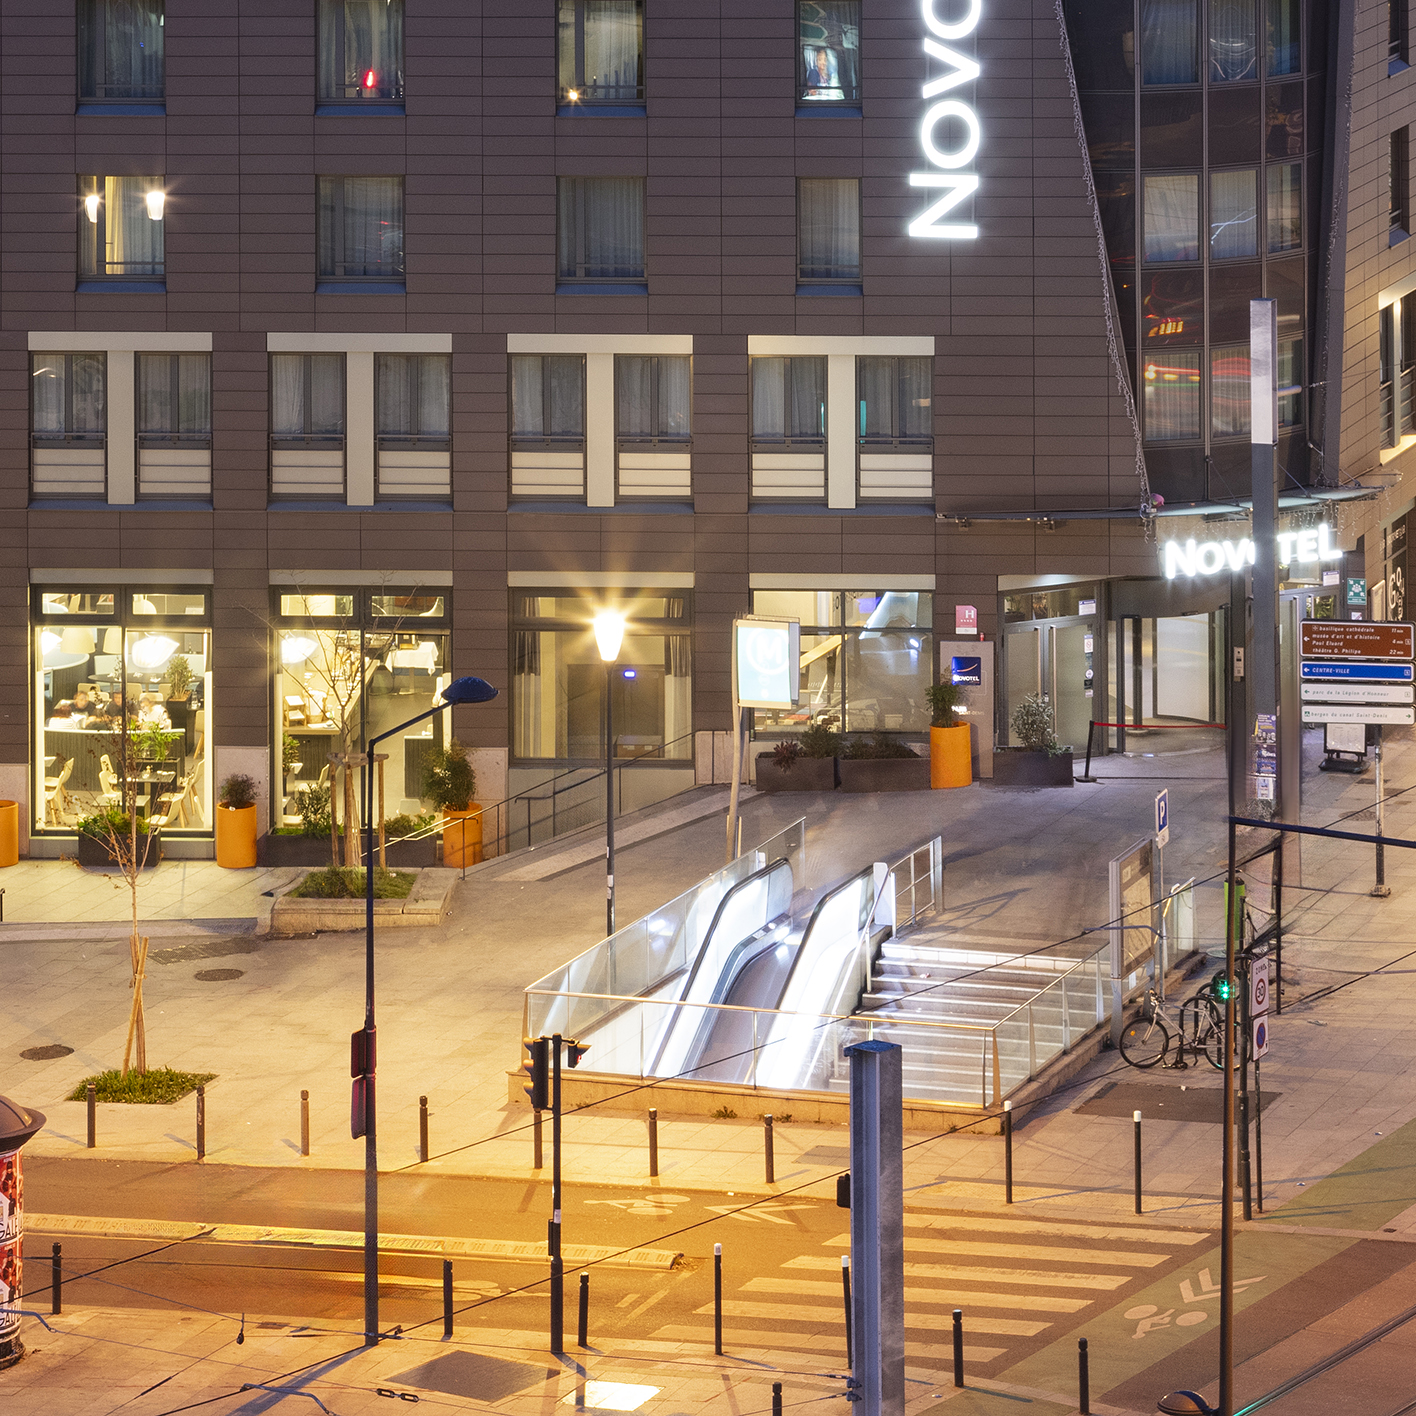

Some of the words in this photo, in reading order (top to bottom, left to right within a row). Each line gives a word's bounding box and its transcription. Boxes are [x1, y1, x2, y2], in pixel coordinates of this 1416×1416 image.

[1165, 523, 1343, 579] NOVTEL
[965, 609, 975, 619] H
[756, 634, 782, 664] M
[1159, 801, 1166, 825] P
[1255, 964, 1267, 975] ZONE
[1257, 985, 1264, 998] 30
